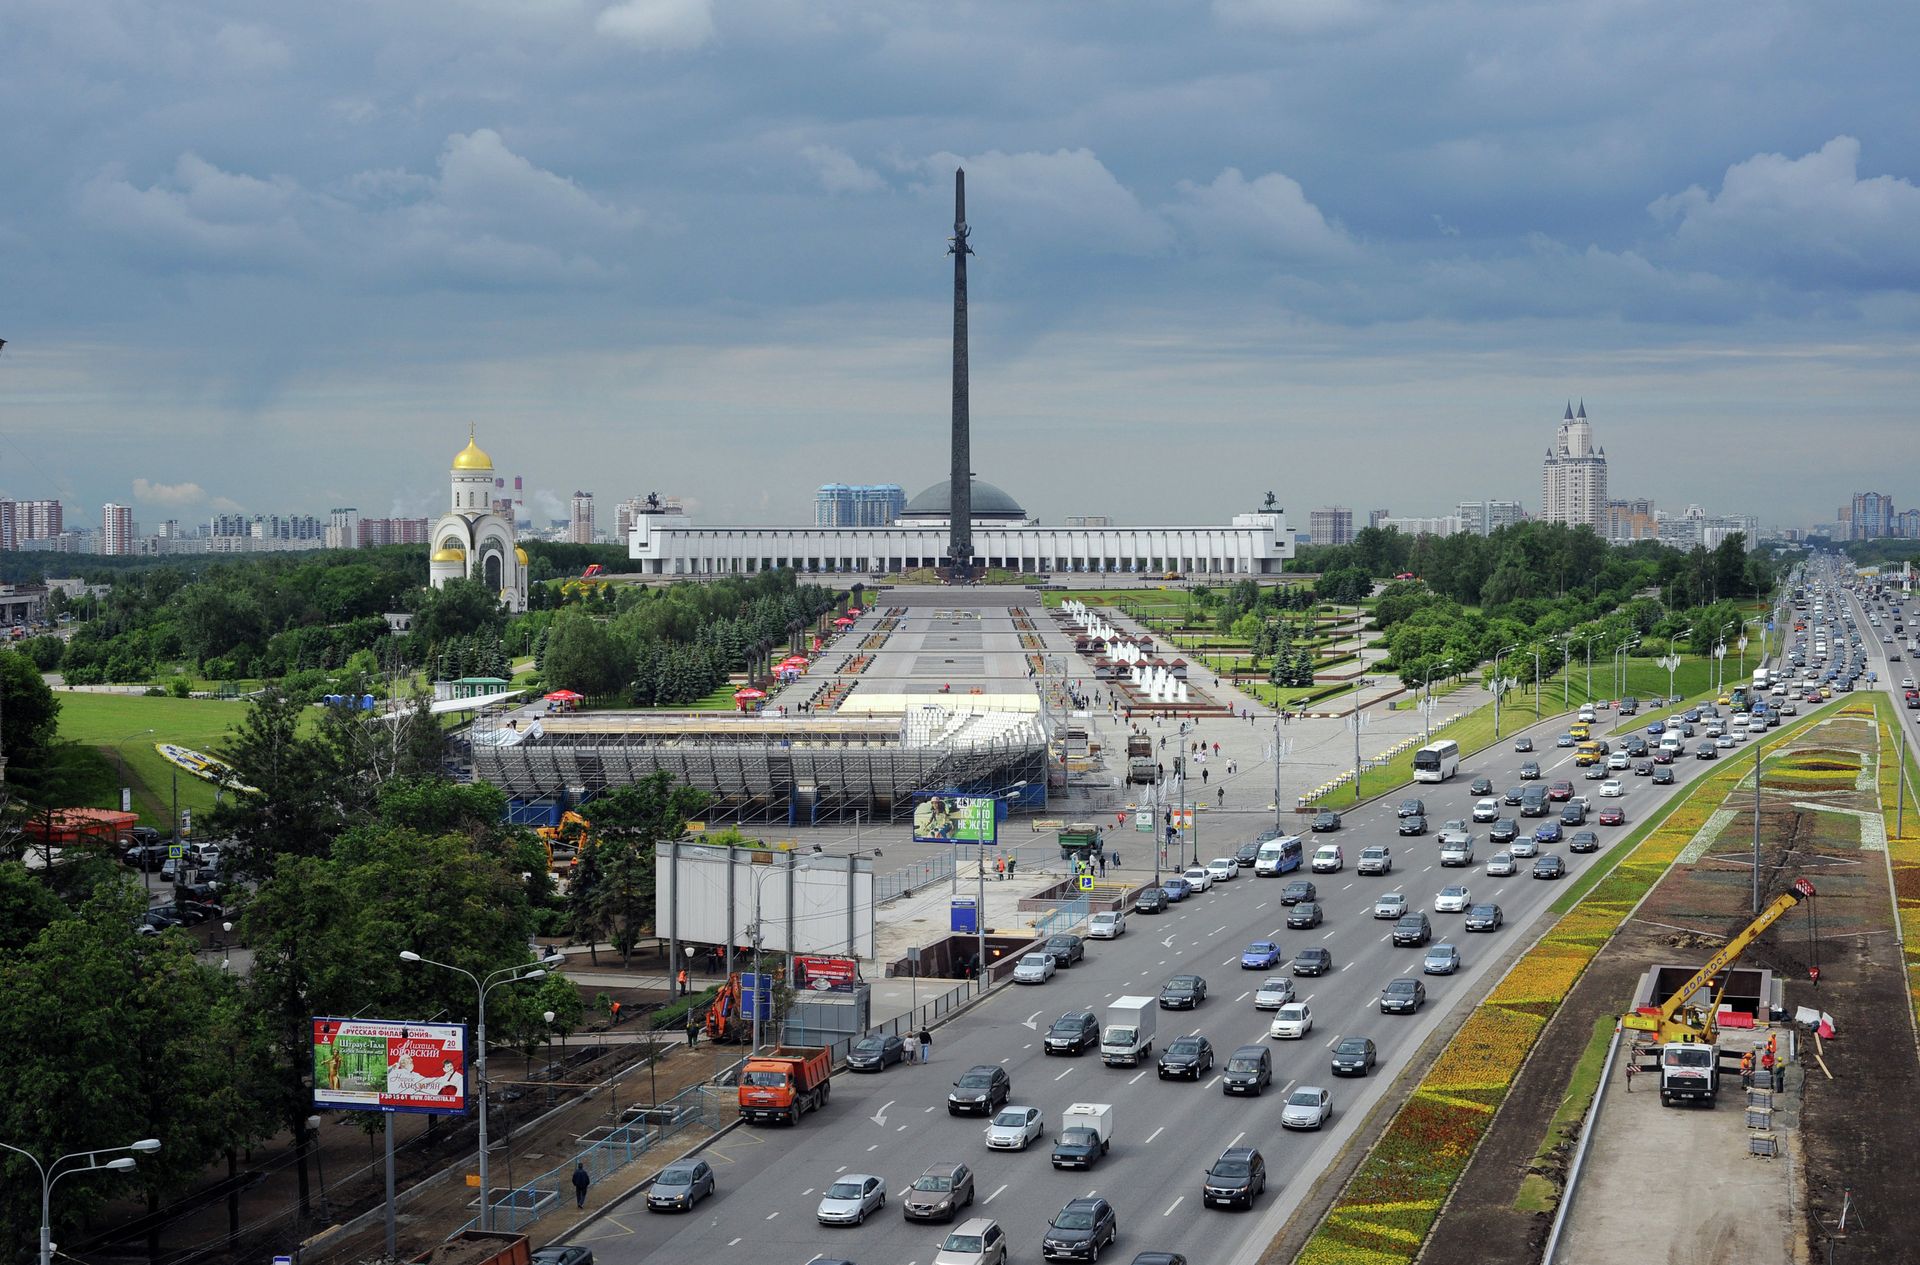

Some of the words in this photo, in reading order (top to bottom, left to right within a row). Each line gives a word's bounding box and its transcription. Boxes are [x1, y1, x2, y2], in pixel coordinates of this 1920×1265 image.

[957, 819, 967, 830] НЕ
[1683, 951, 1728, 996] ДОРМОСТ
[343, 1028, 377, 1036] «РУССКАЯ
[377, 1029, 433, 1038] ФИЛАРОНИЯ»
[339, 1039, 385, 1050] Штраус-Гала
[397, 1040, 436, 1049] Михаил
[389, 1048, 440, 1058] ЮРОВСКИЙ
